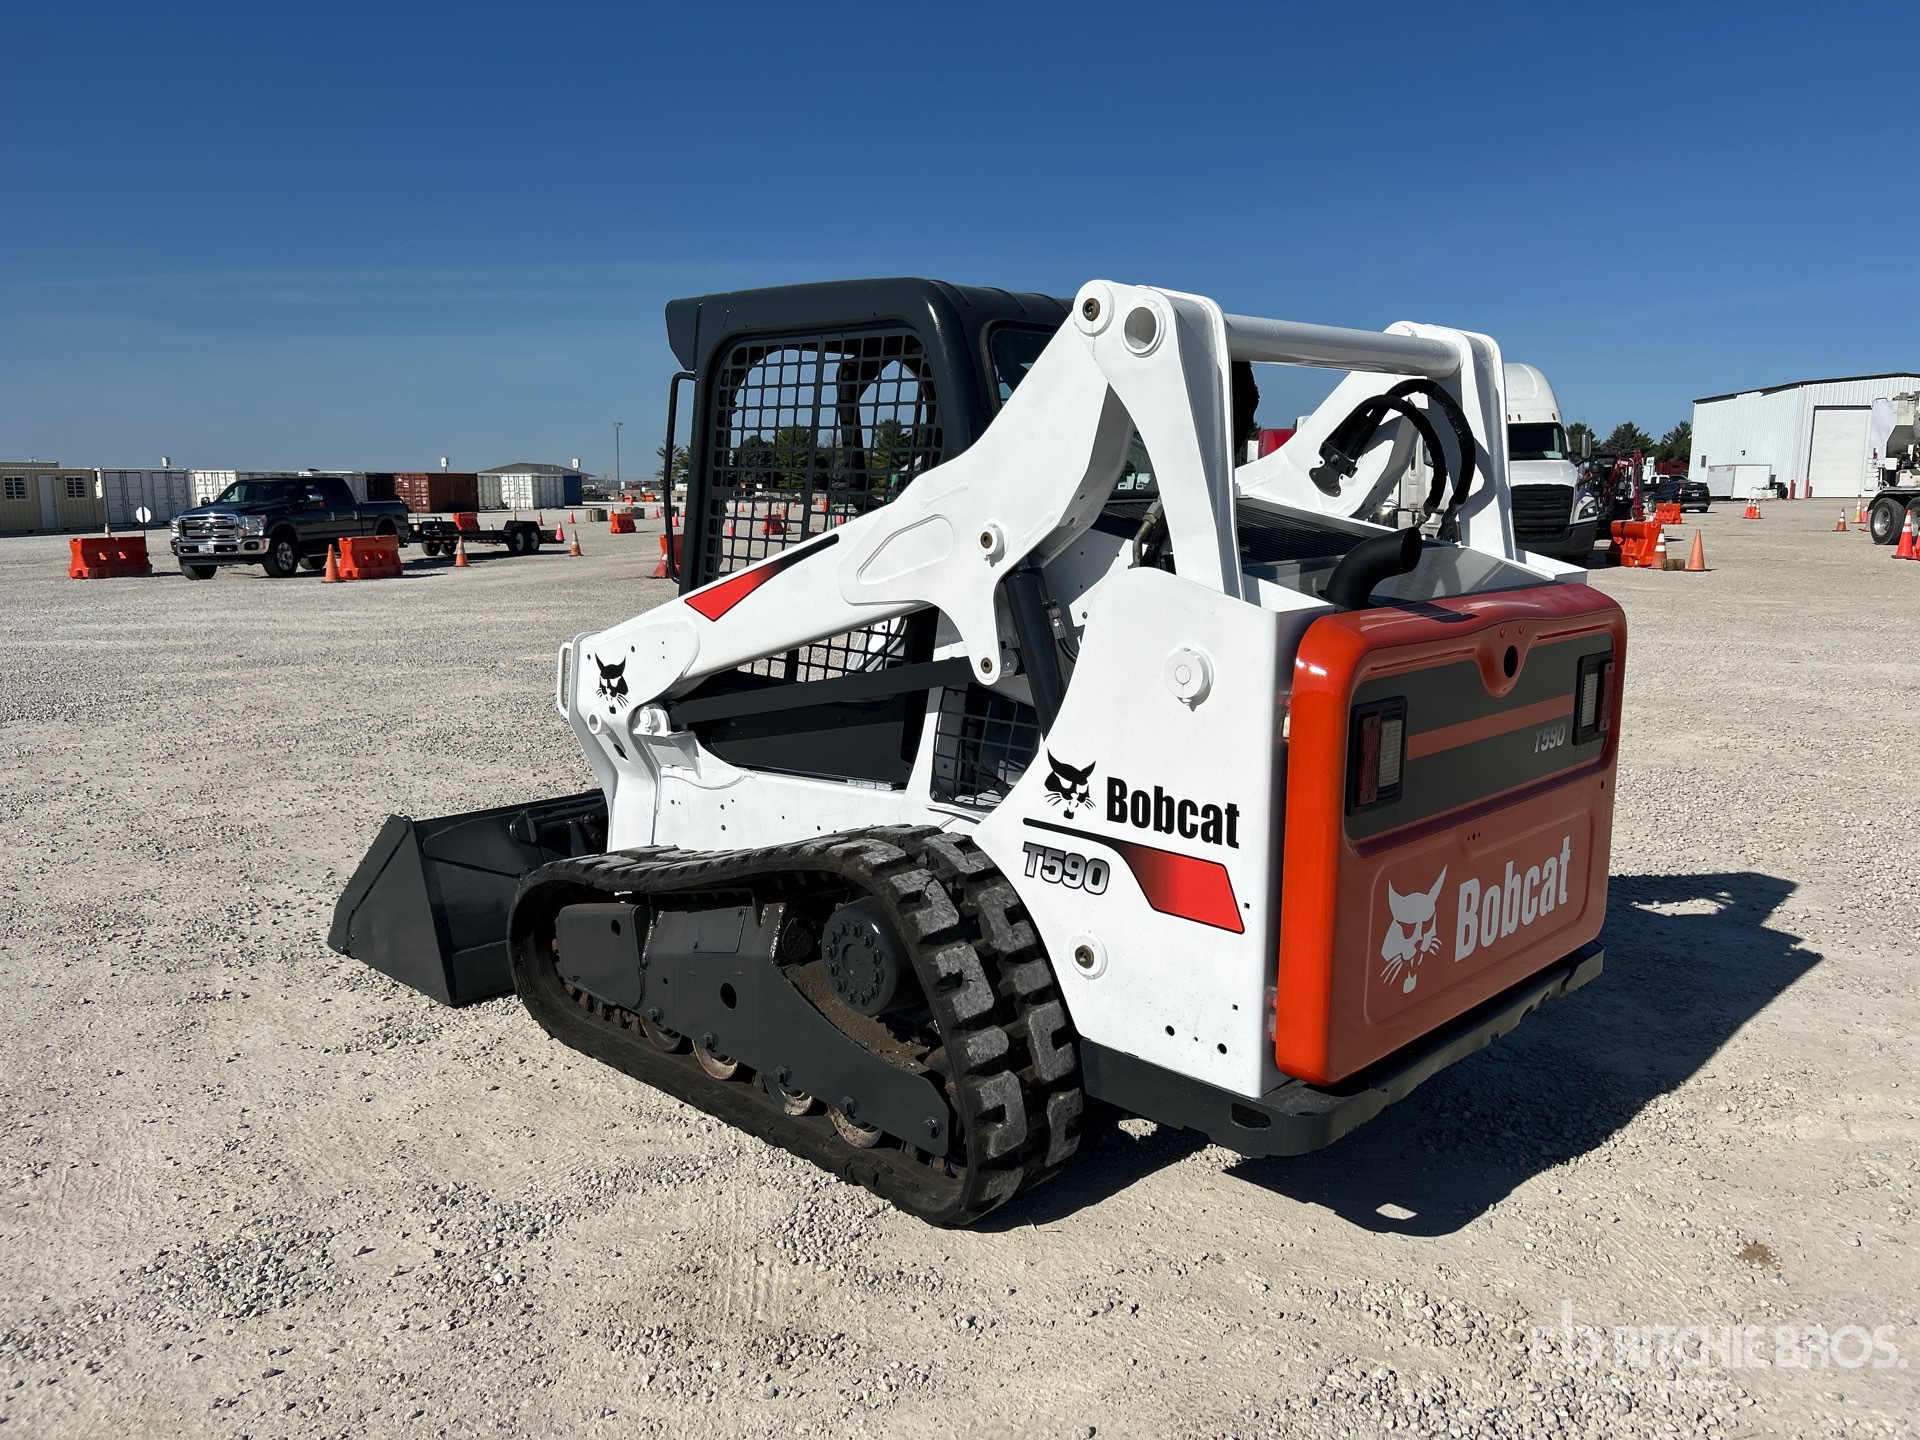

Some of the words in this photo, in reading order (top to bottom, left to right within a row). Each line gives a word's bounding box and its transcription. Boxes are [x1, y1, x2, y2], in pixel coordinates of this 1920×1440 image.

[1533, 722, 1567, 754] T590
[1106, 776, 1240, 849] Bobcat
[1022, 841, 1110, 896] T590
[1454, 835, 1571, 963] Bobcat
